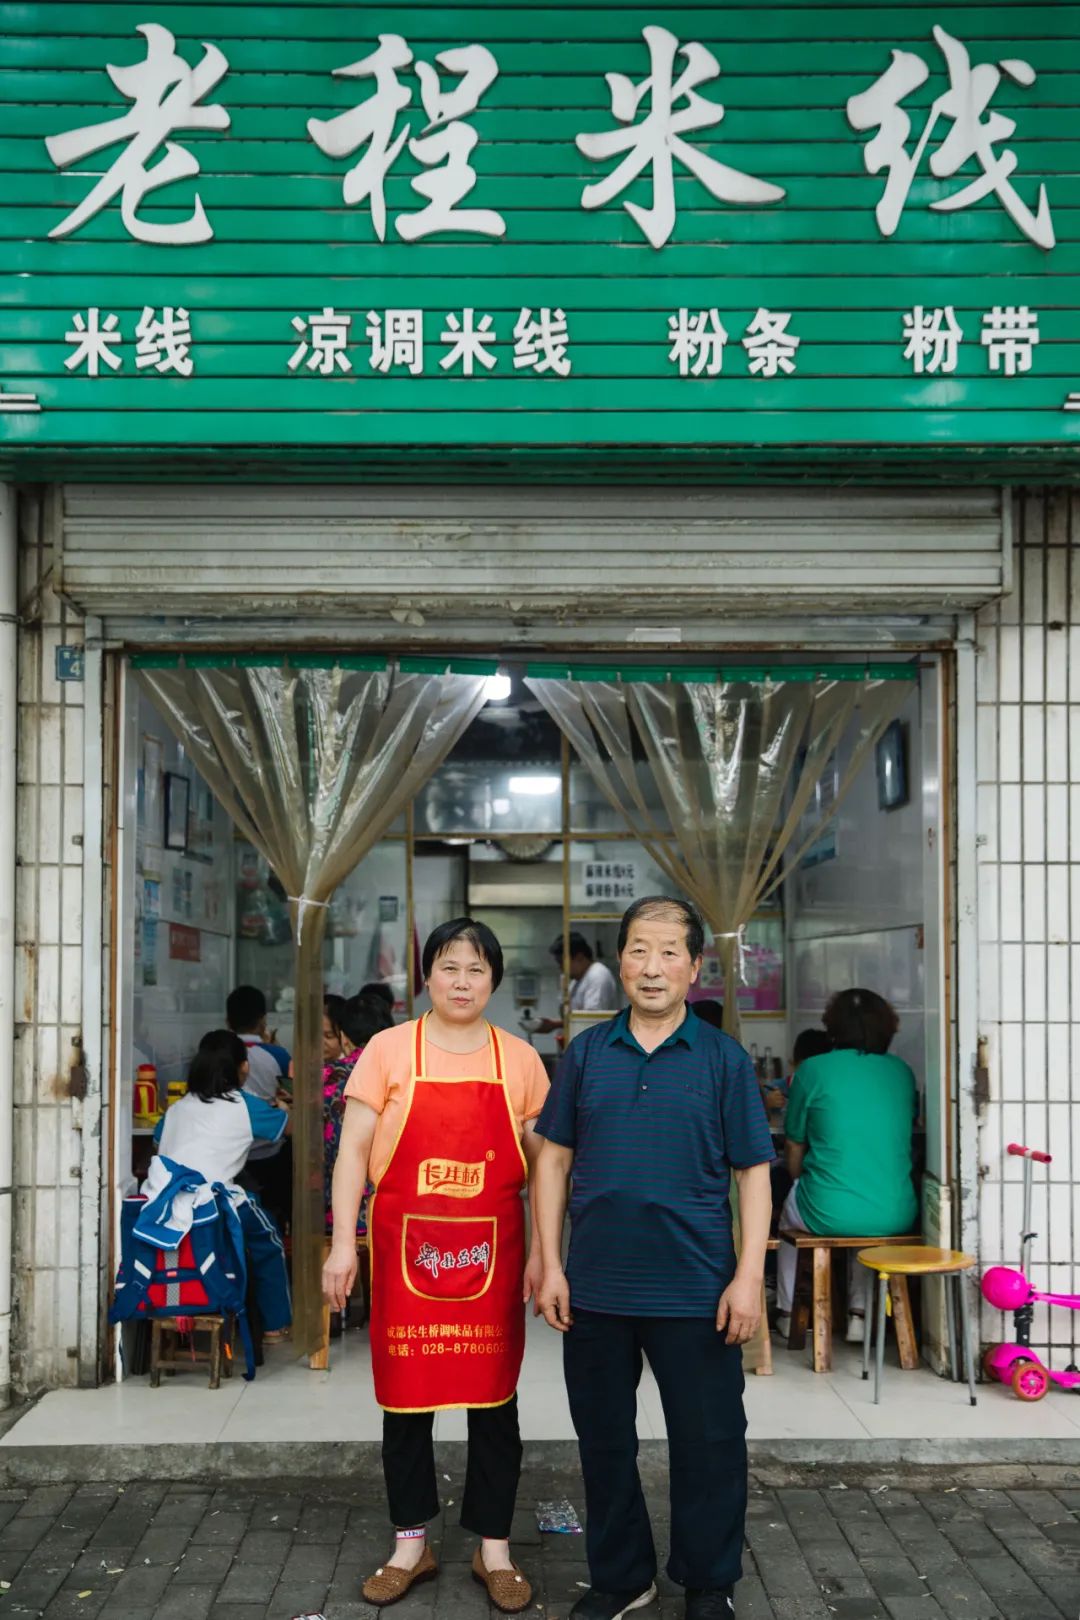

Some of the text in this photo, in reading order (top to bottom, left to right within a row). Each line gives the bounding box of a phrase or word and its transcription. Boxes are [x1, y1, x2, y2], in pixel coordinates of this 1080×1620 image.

[45, 23, 1056, 250] 老程米线
[64, 305, 1040, 377] 米线 凉调米线 粉条 粉带
